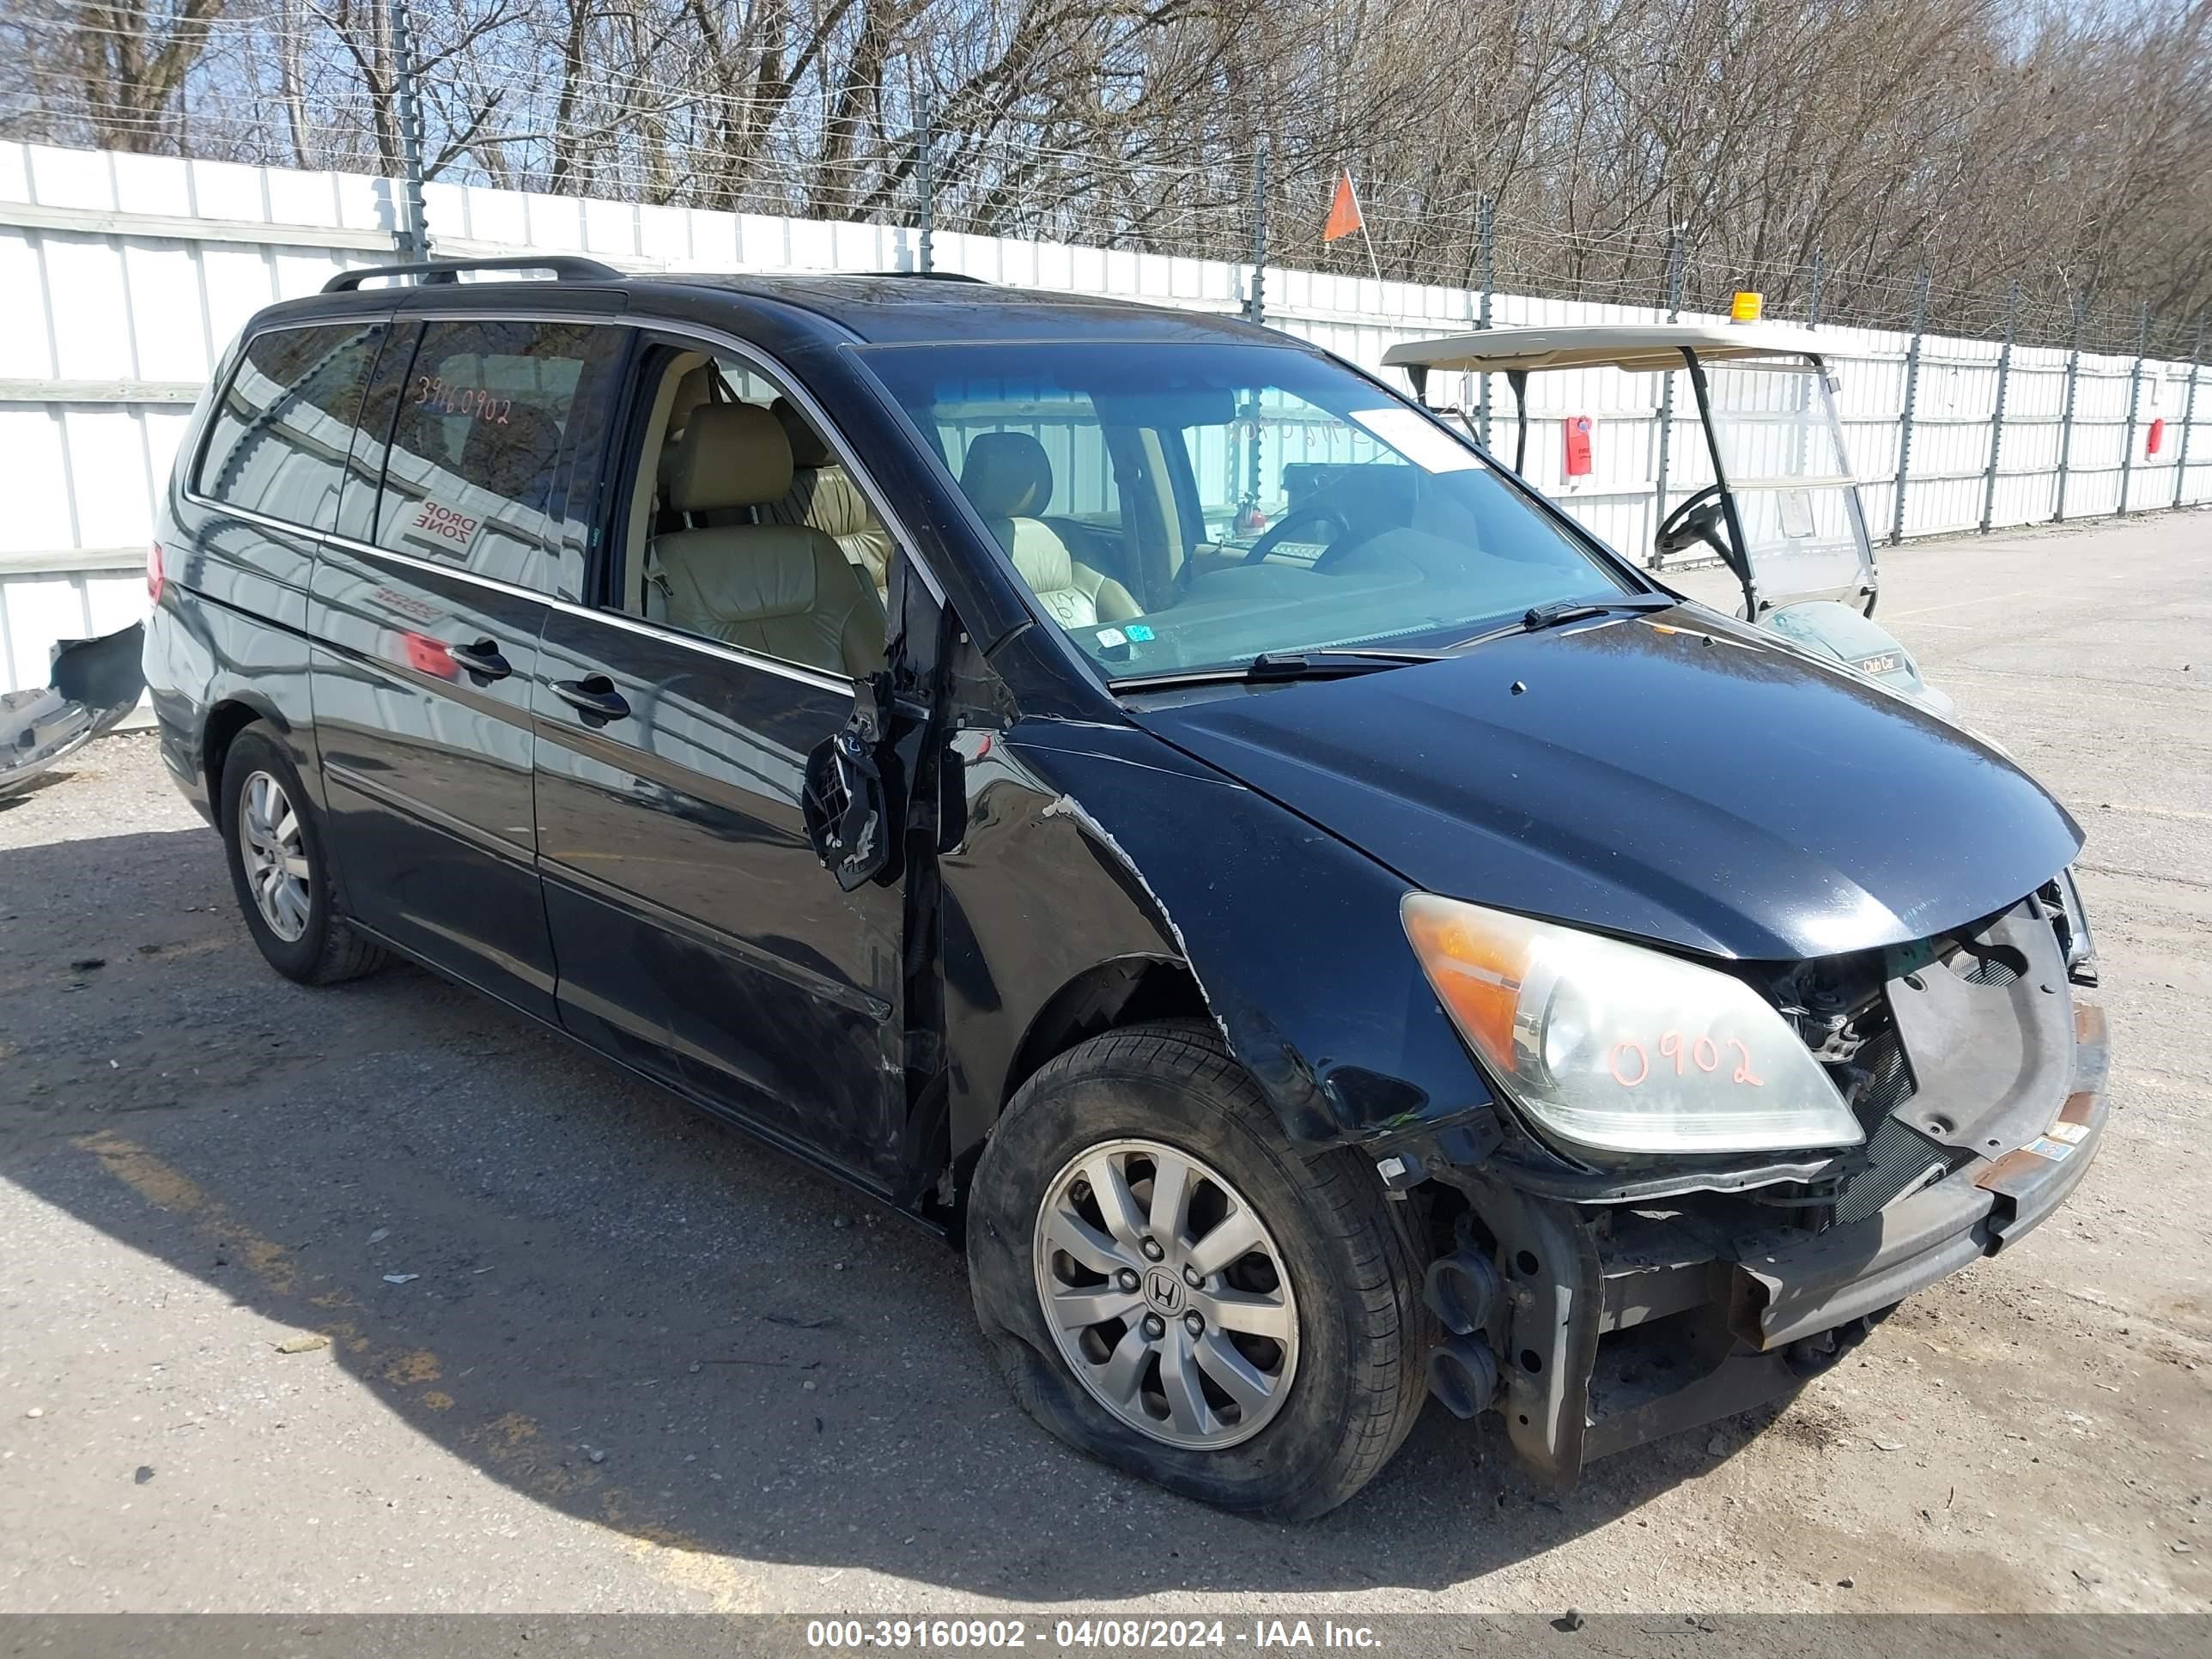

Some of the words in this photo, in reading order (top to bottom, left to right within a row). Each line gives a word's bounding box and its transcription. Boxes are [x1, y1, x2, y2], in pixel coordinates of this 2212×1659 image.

[415, 376, 511, 424] 39160902
[1863, 658, 1881, 674] Club
[1881, 656, 1894, 670] Car
[1607, 1029, 1765, 1087] 0902
